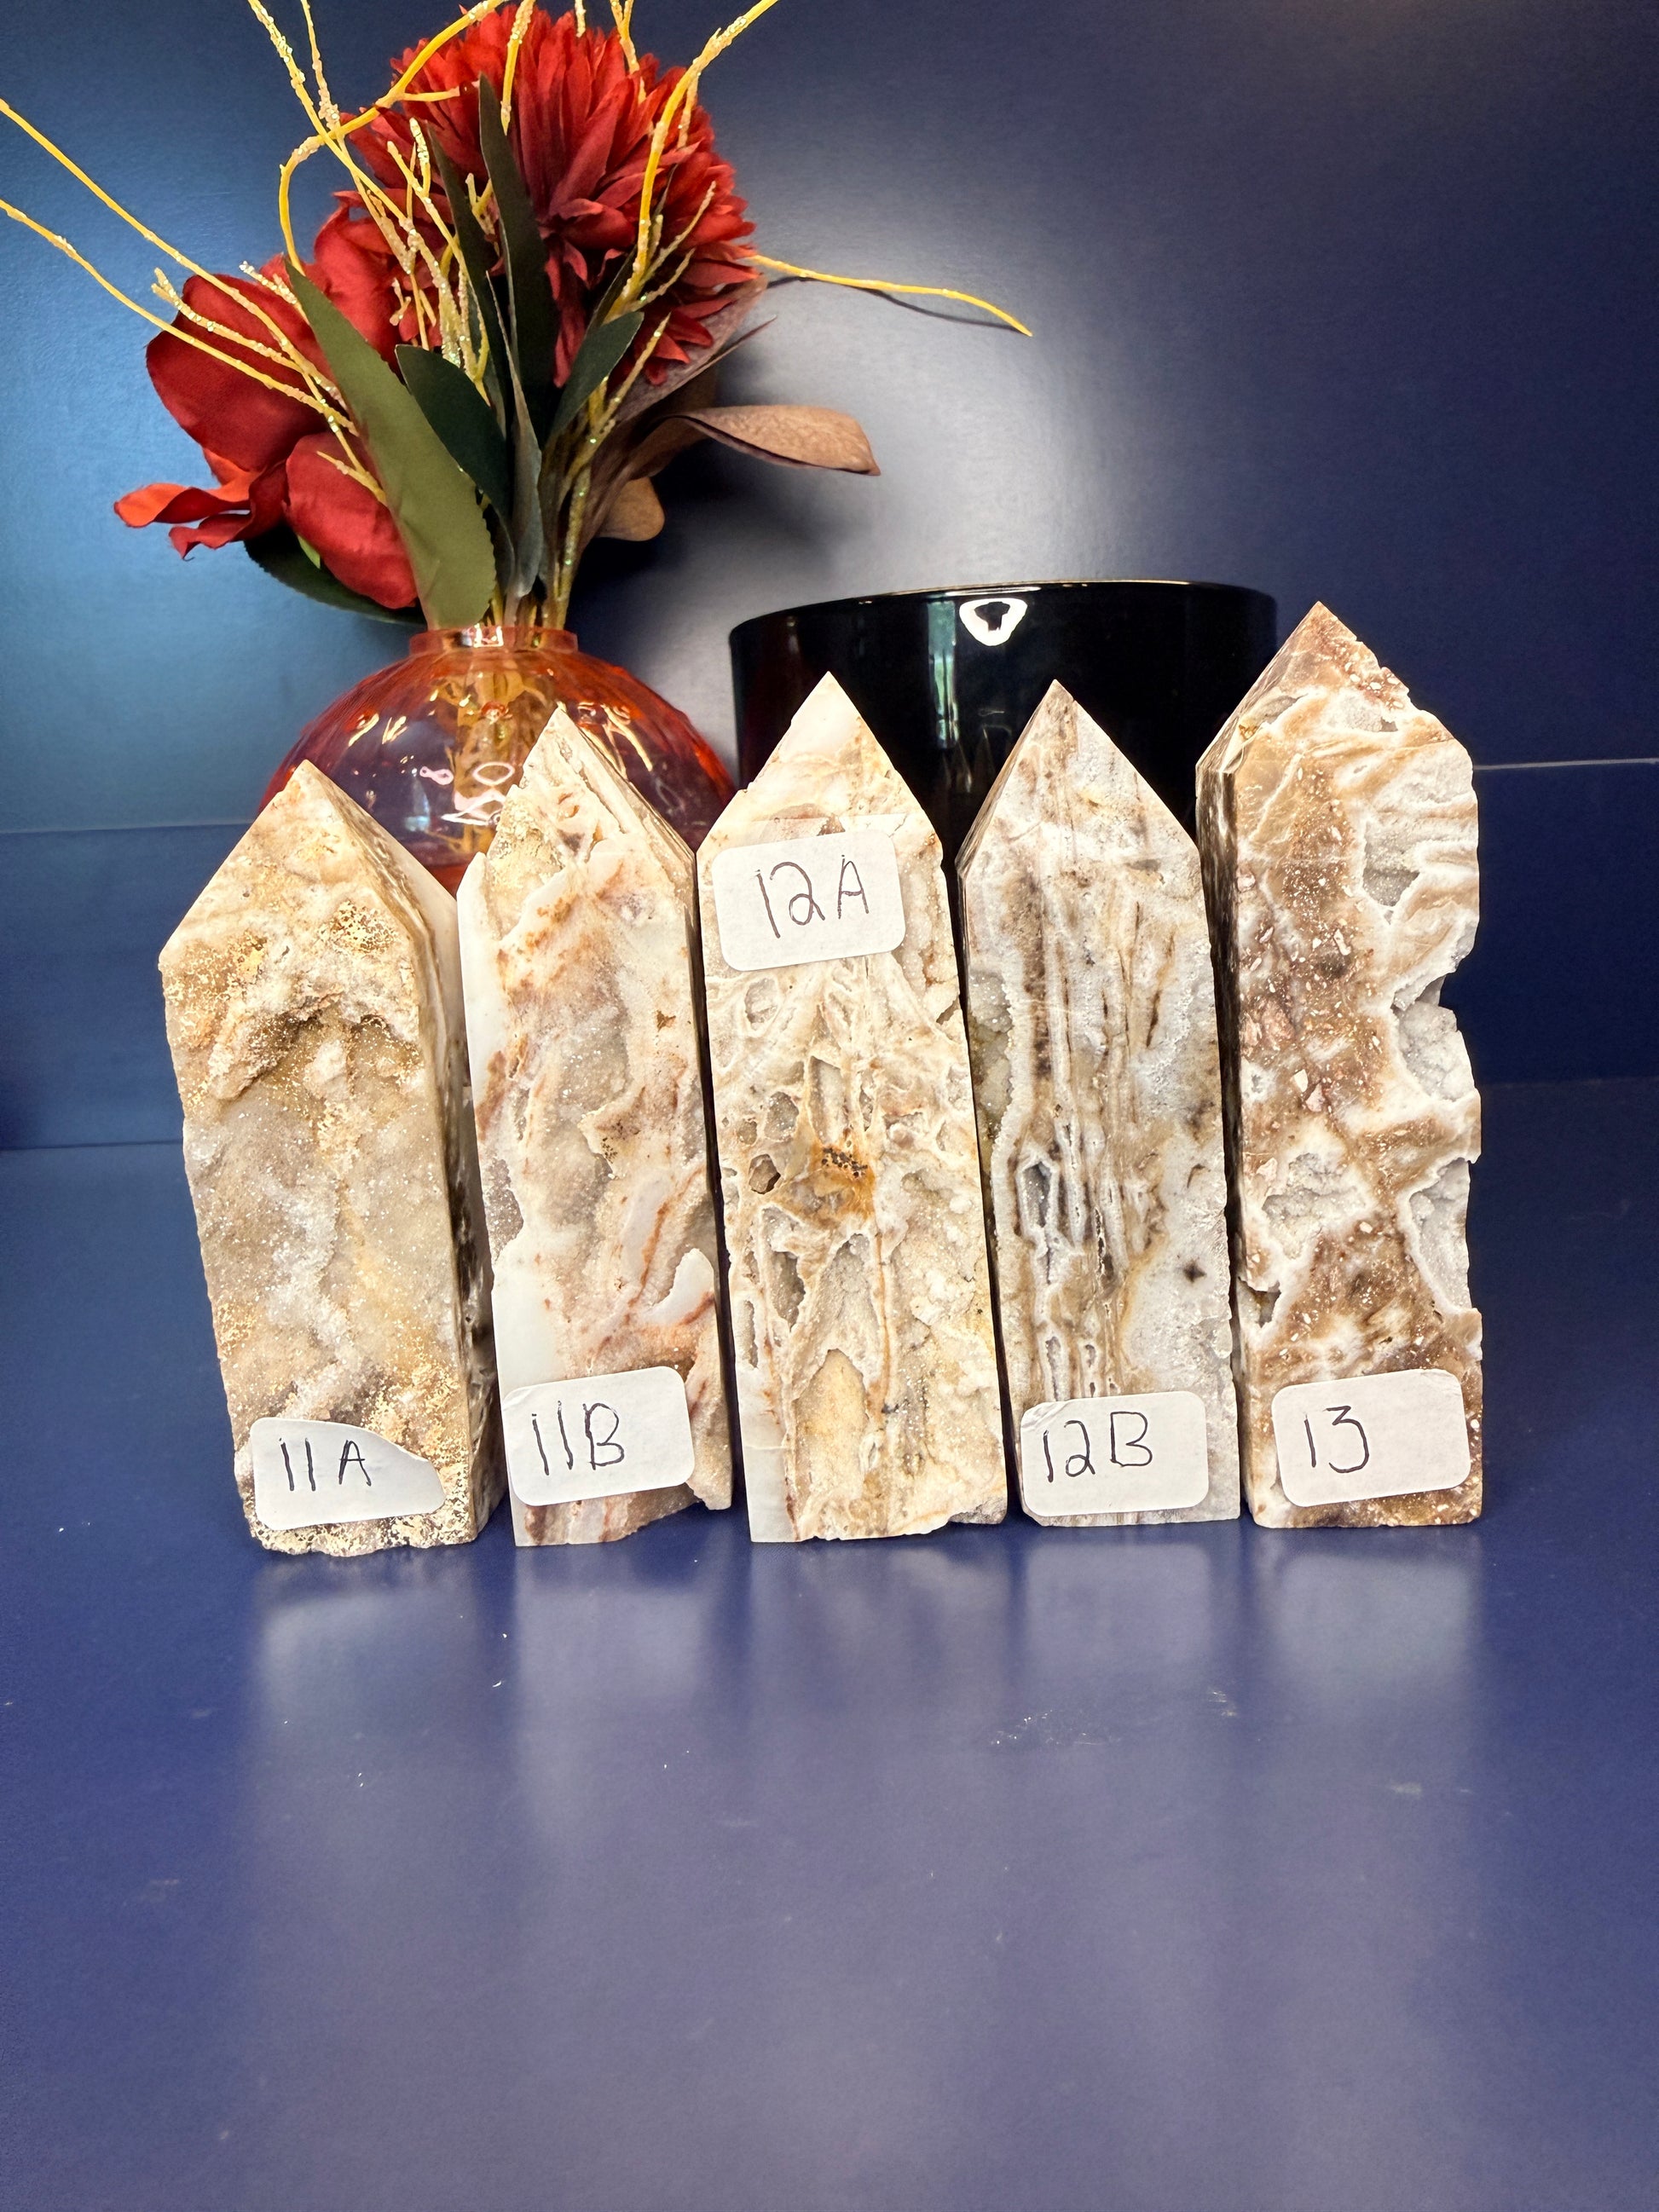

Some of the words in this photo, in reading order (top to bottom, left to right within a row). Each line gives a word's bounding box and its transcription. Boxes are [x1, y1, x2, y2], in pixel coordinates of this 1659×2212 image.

[755, 854, 870, 939] 12A
[280, 1439, 373, 1493] 11A
[532, 1401, 626, 1476] 11B
[1042, 1410, 1153, 1484] 12B
[1303, 1404, 1371, 1475] 13
